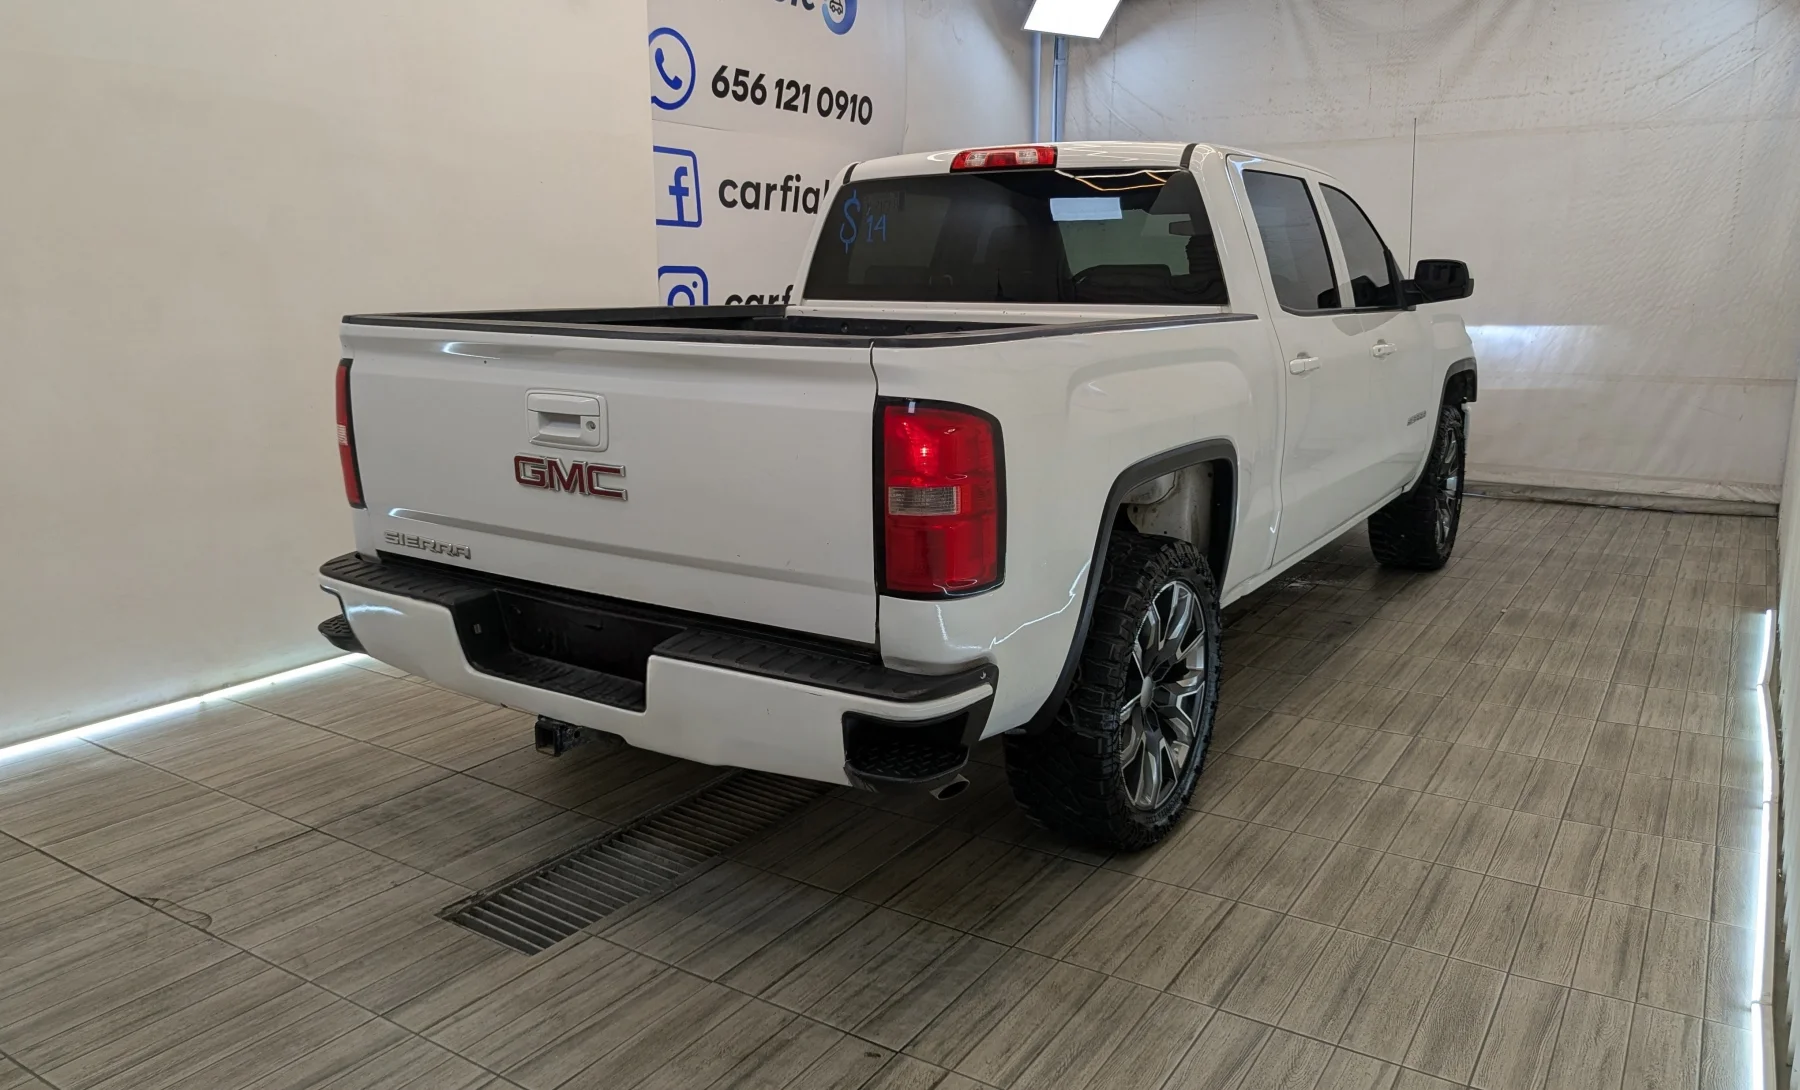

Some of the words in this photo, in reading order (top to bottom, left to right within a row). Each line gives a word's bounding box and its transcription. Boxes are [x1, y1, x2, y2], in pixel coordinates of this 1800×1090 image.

[711, 64, 767, 106] 656
[774, 78, 811, 114] 121
[816, 86, 873, 125] 0910
[513, 454, 628, 502] GMC
[383, 530, 472, 561] SIERRA
